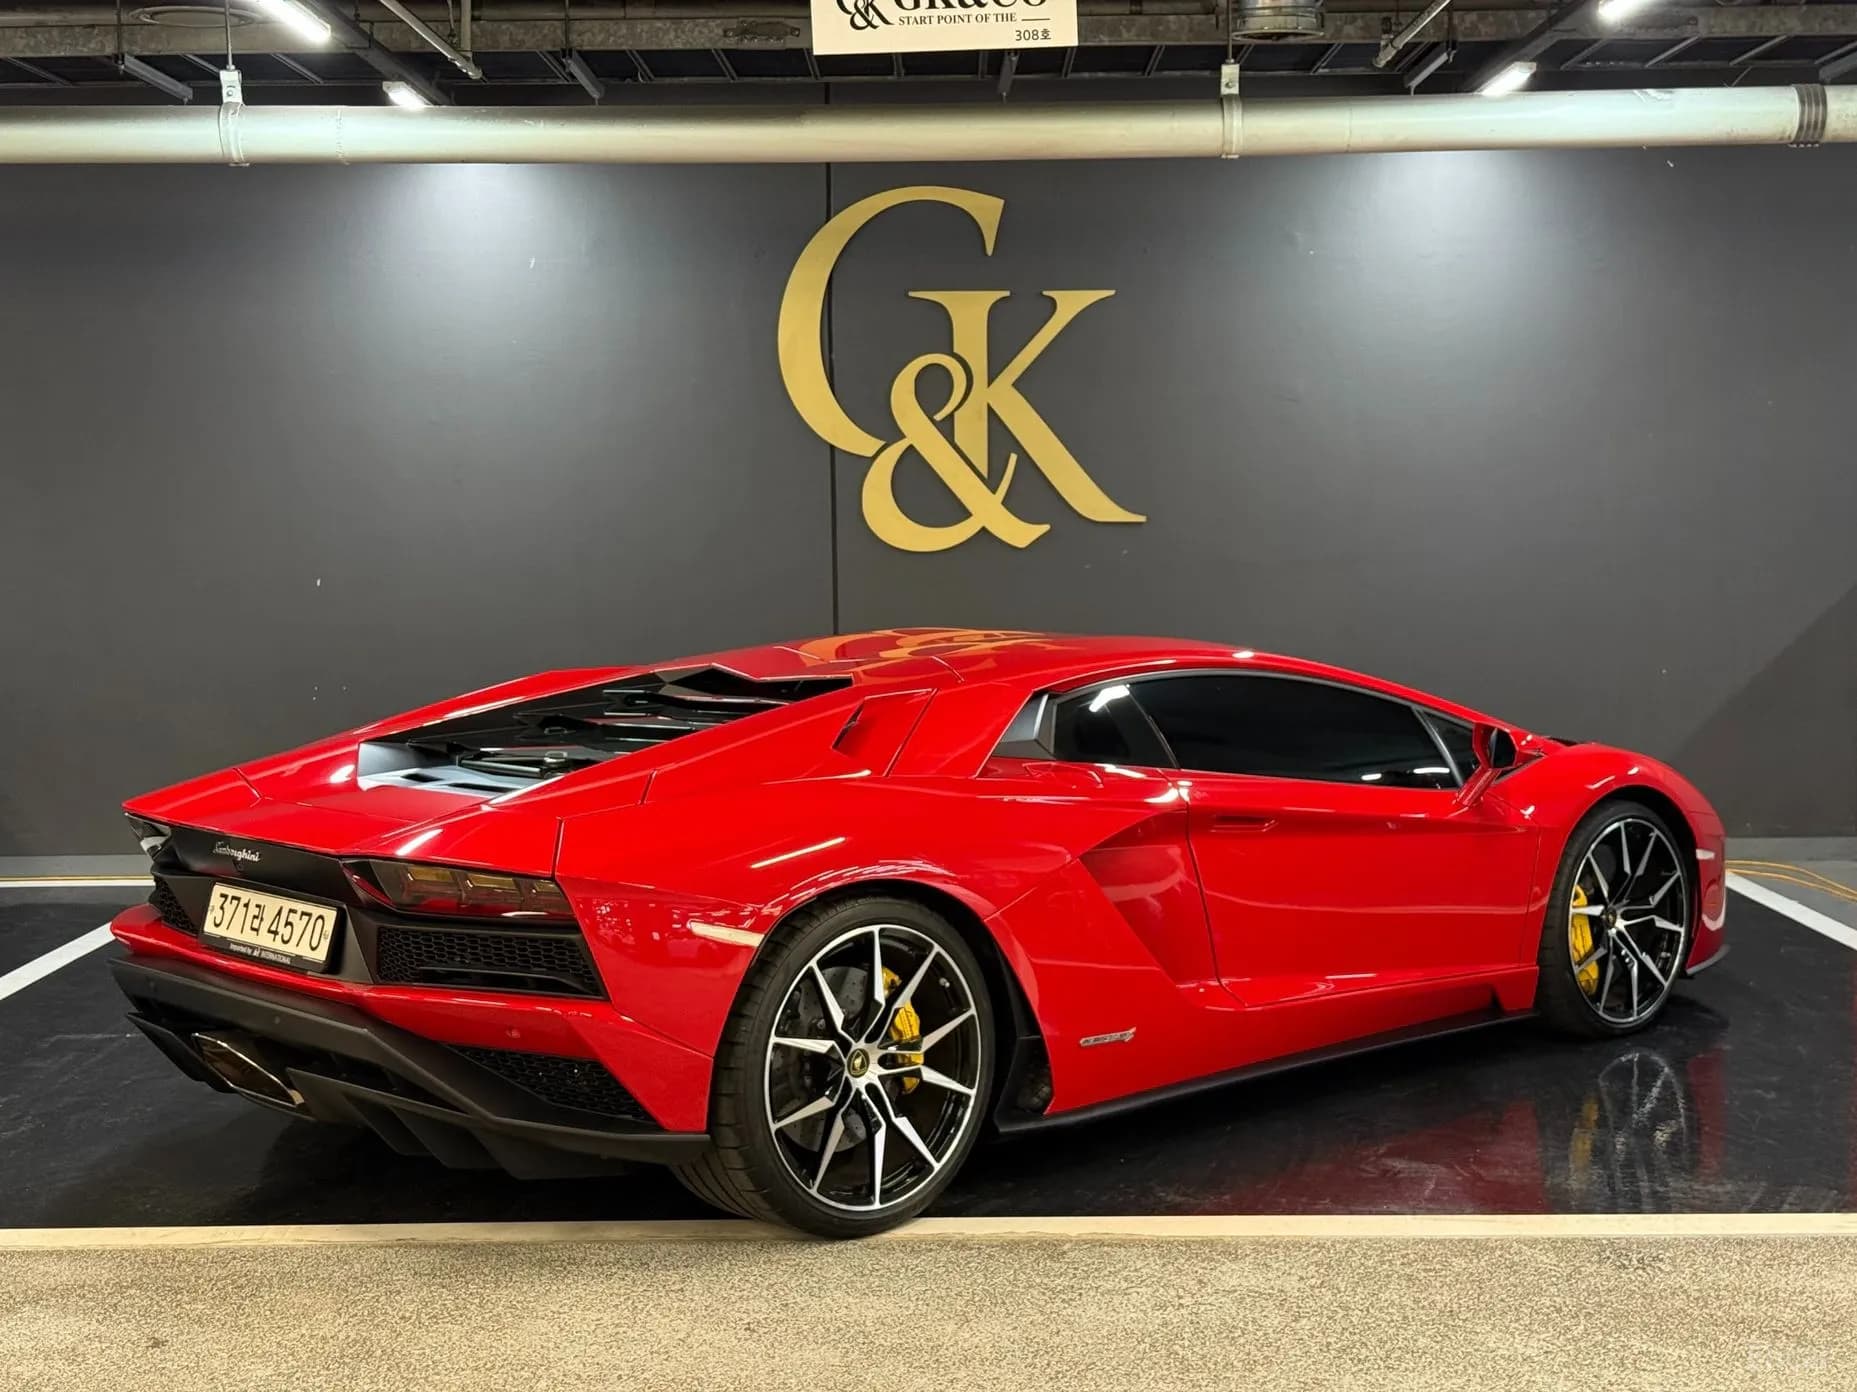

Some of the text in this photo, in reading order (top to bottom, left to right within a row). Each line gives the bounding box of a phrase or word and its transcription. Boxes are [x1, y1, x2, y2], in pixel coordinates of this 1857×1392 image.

[899, 13, 1017, 26] START POINT OF THE
[1015, 29, 1051, 41] 308호
[212, 841, 261, 862] Lamborghini
[267, 905, 326, 952] 4570
